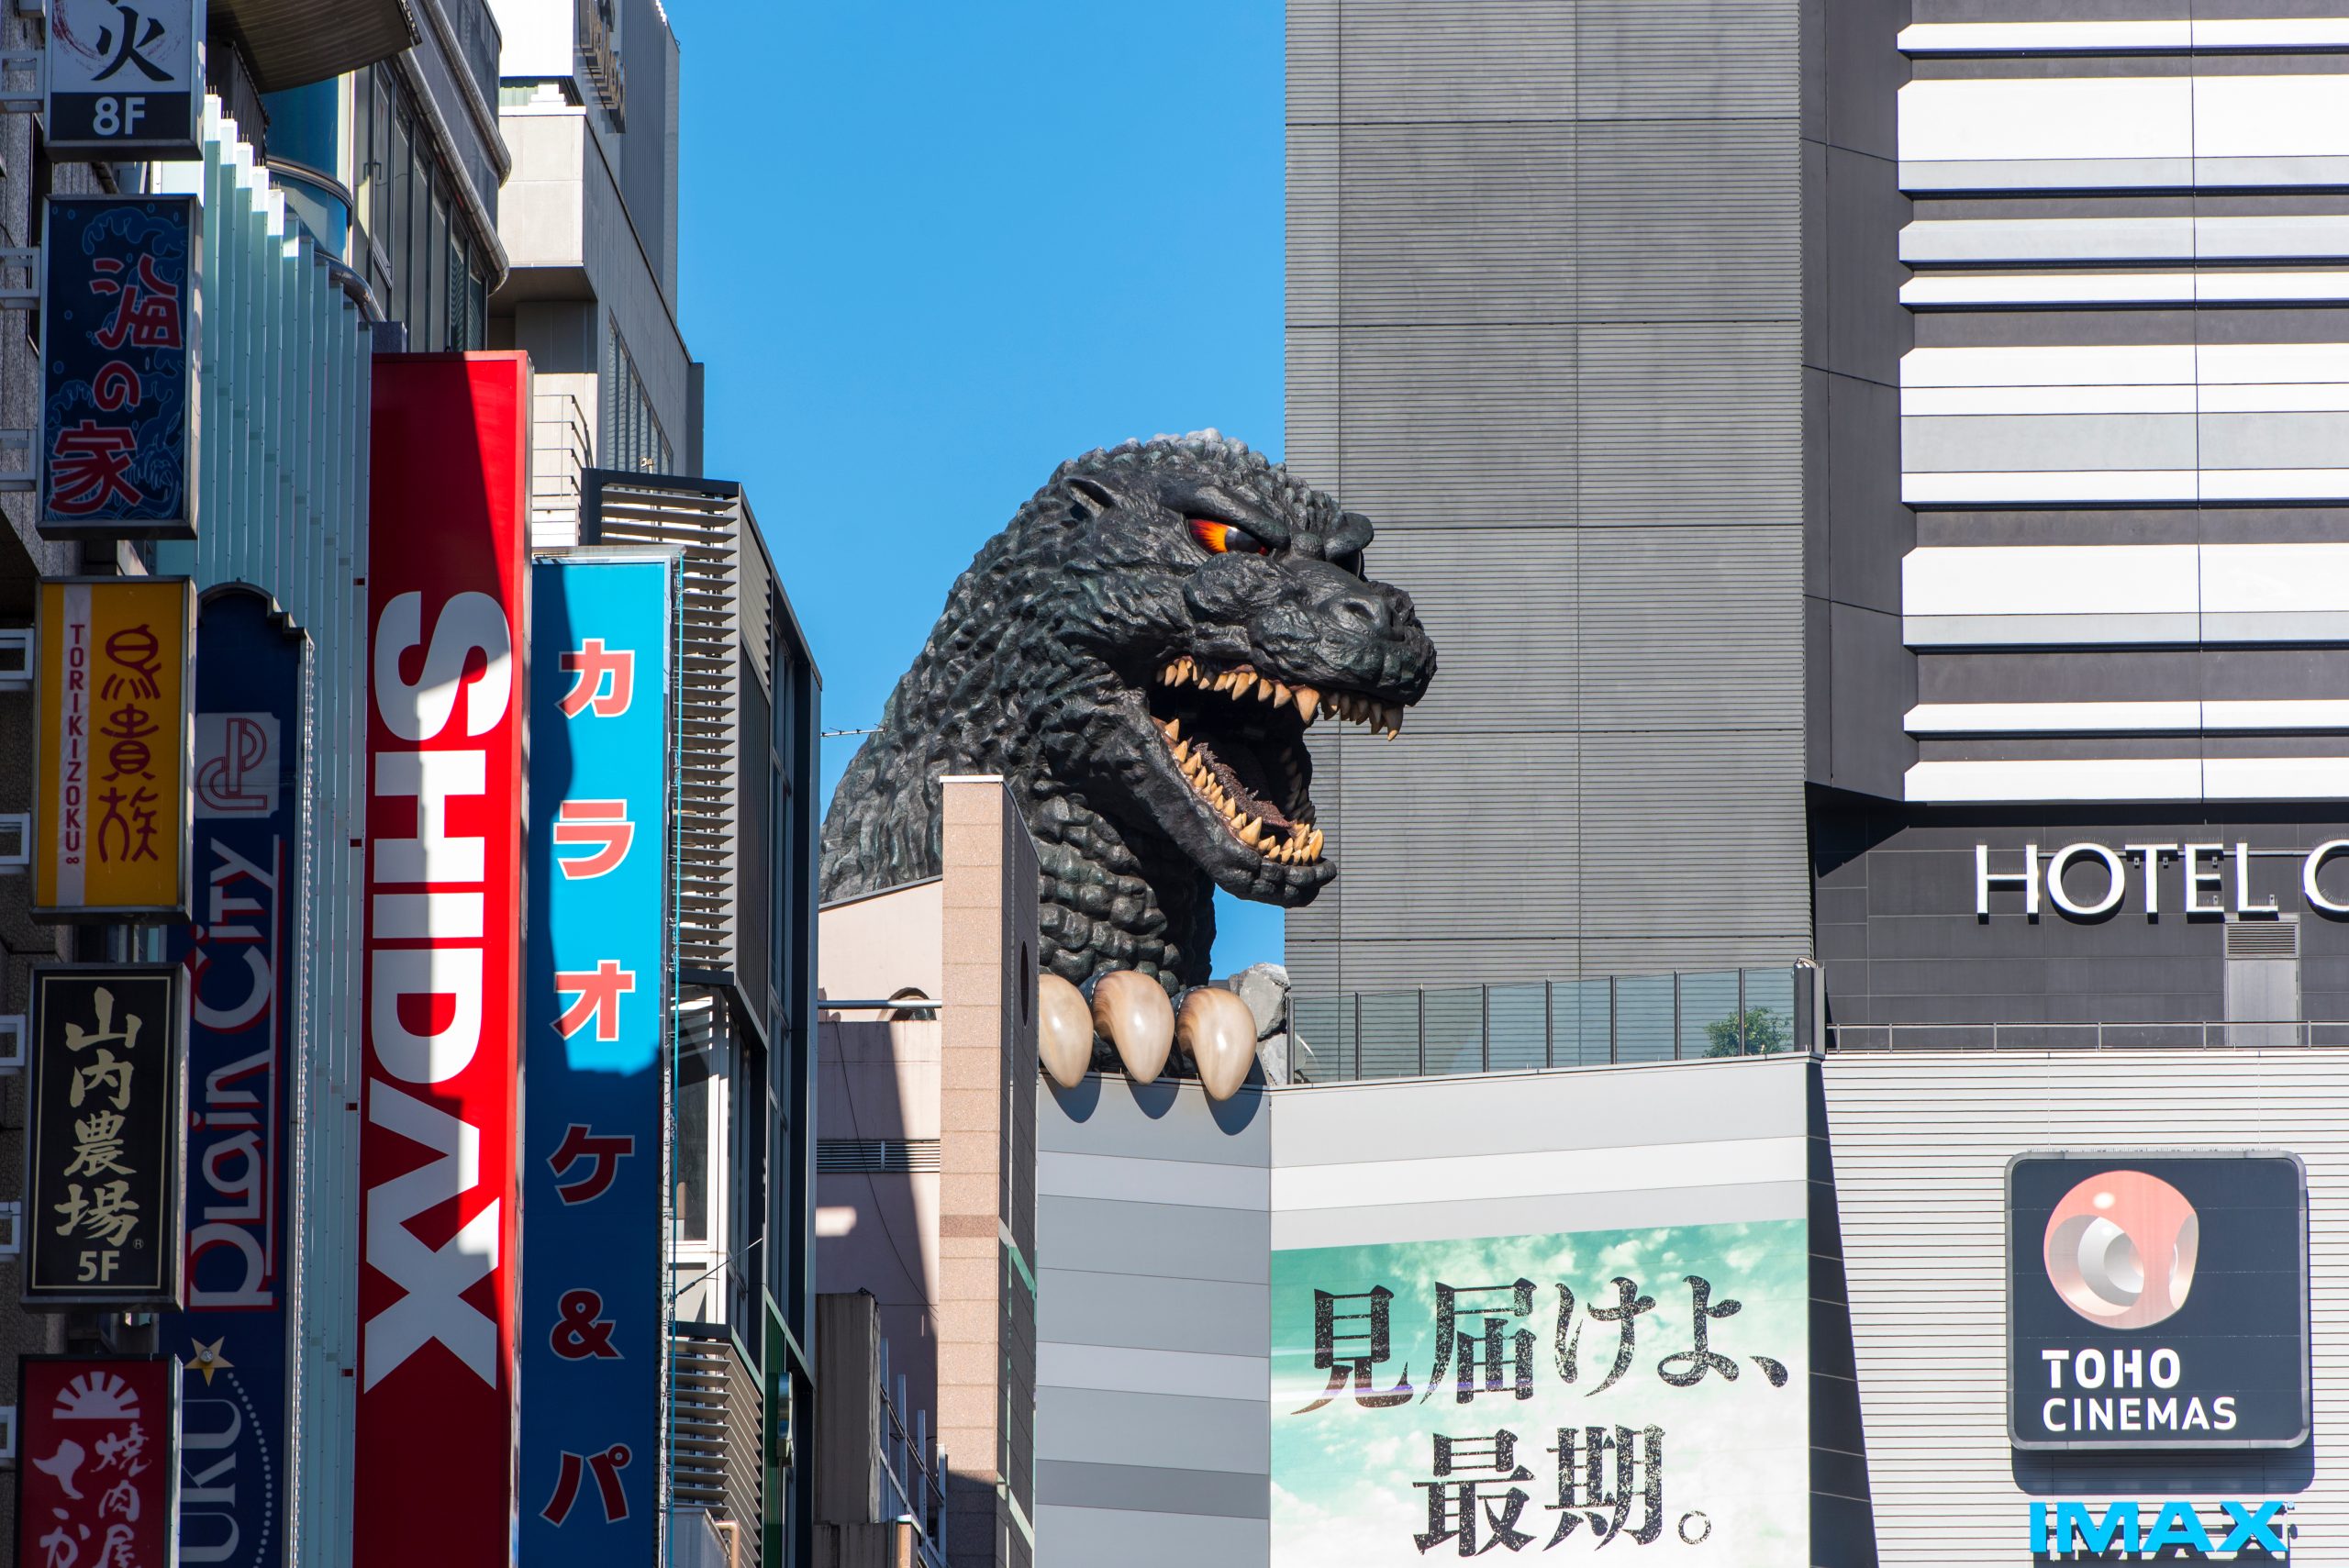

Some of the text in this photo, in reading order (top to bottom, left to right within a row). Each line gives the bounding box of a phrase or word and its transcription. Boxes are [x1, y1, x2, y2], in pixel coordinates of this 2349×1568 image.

[92, 95, 147, 137] 8F
[48, 252, 183, 516] 海の家
[65, 623, 86, 852] TORIKIZOKU
[97, 624, 162, 862] 鳥貴族
[1976, 842, 2279, 915] HOTEL
[363, 590, 513, 1395] SHIDAX
[54, 986, 143, 1248] 山内農場
[77, 1250, 120, 1283] 5F
[1290, 1275, 1788, 1415] 見届けよ、
[2042, 1348, 2181, 1389] TOHO
[2043, 1396, 2237, 1432] CINEMAS
[1412, 1423, 1712, 1558] 最期。
[2030, 1501, 2289, 1552] IMAX
